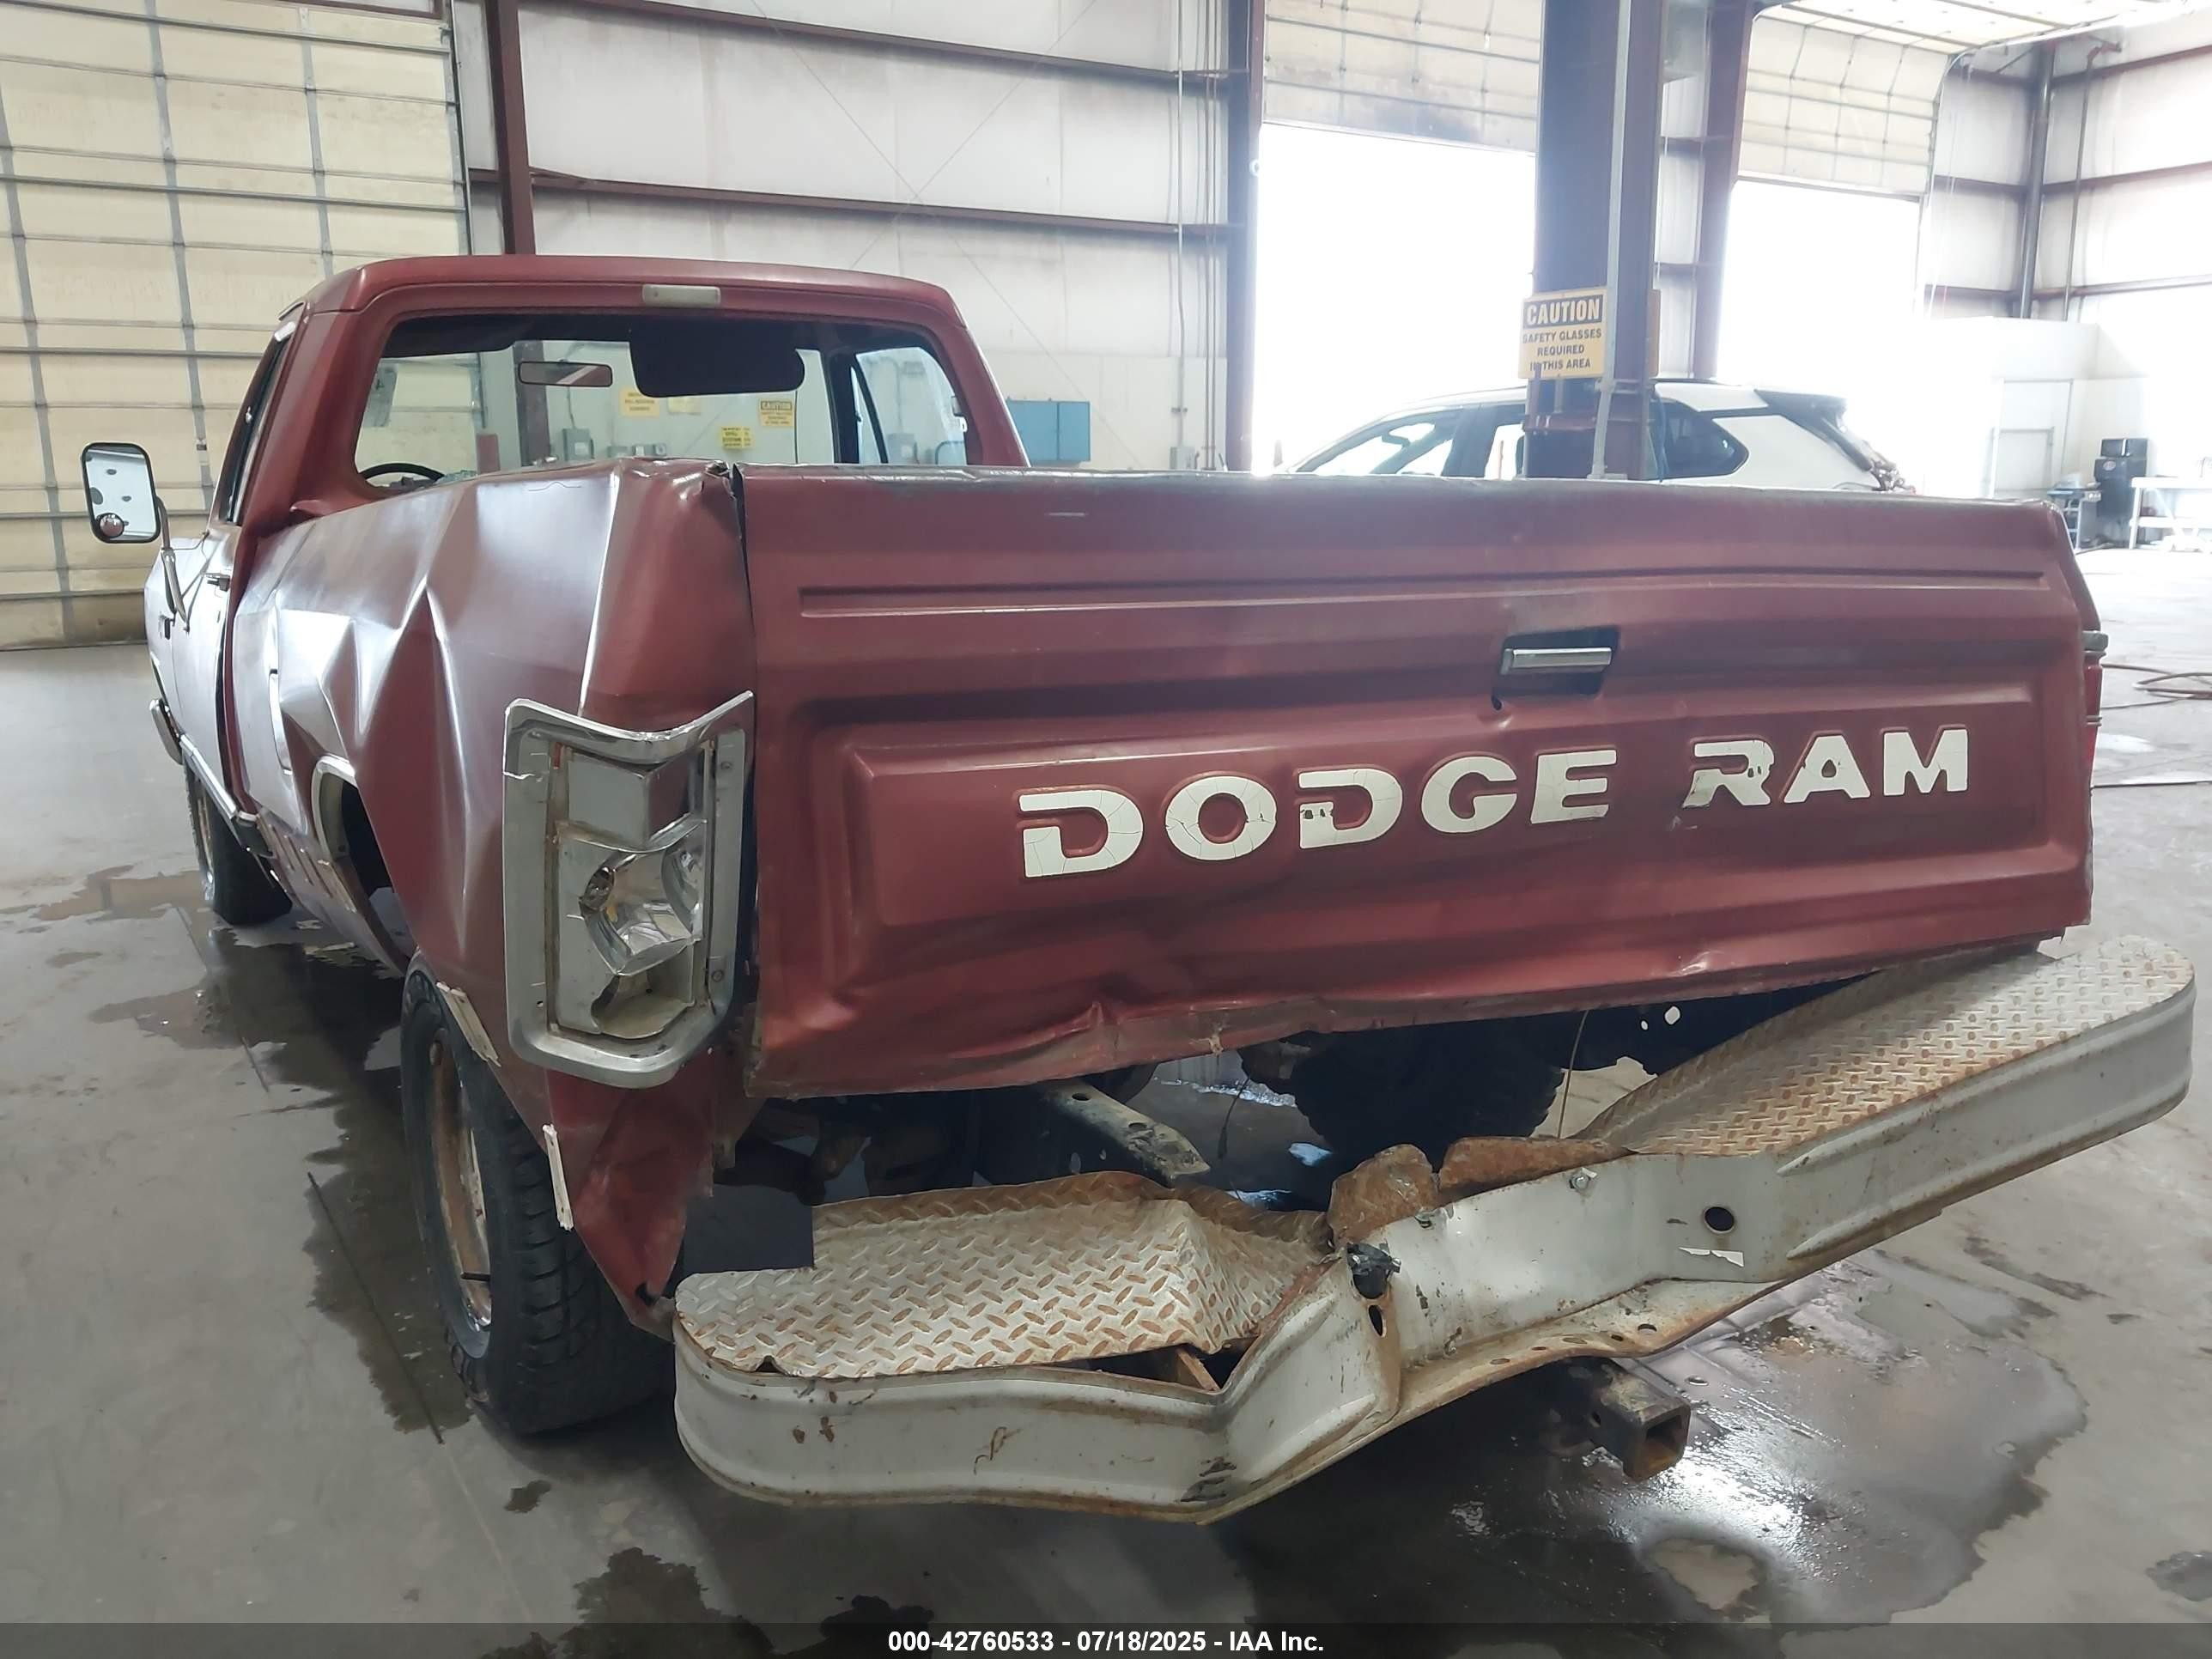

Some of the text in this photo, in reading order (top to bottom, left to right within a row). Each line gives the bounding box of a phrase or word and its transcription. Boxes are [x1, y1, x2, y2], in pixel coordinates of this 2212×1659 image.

[1527, 298, 1600, 325] CAUTION
[1522, 328, 1601, 344] SAFETY GLASSES
[1537, 344, 1585, 356] REQUIRED
[1530, 358, 1591, 372] I THIS AREA
[1018, 728, 1969, 878] DODGE RAM
